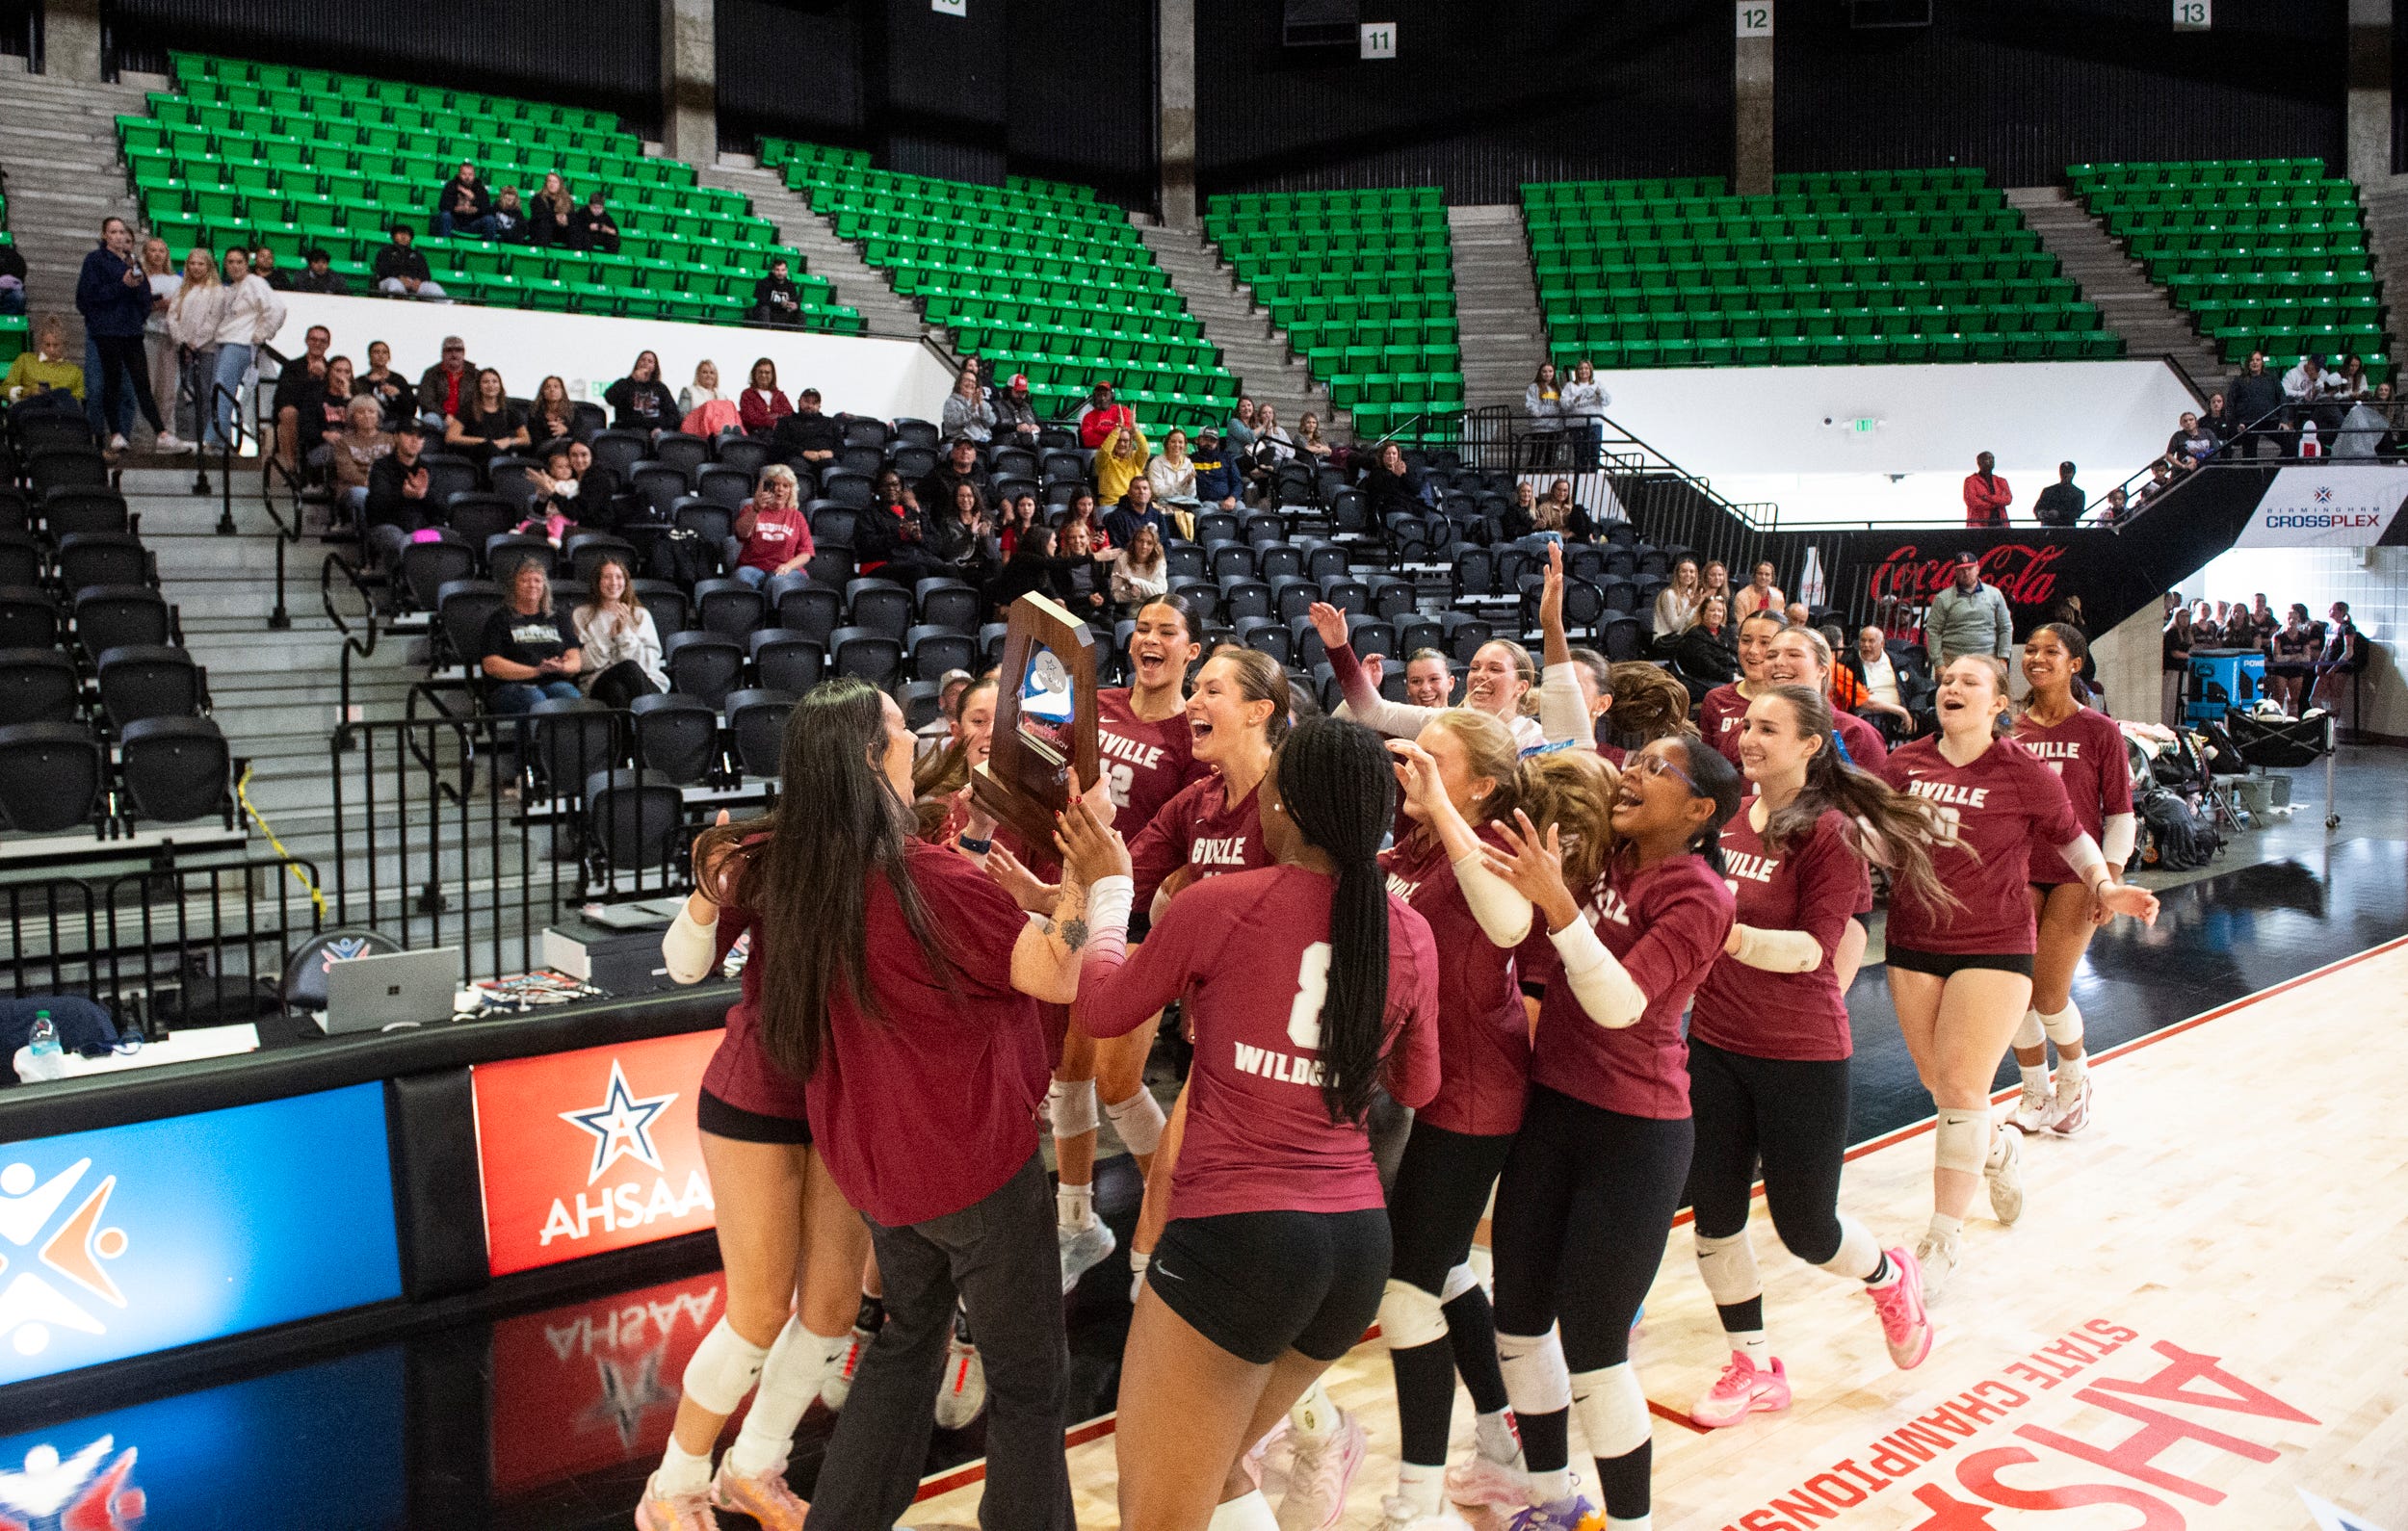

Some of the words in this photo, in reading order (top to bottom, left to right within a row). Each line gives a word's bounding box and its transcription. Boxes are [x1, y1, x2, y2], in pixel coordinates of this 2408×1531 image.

[1742, 9, 1767, 29] 12
[2180, 3, 2205, 23] 13
[1369, 31, 1389, 50] 11
[2265, 514, 2380, 529] CROSSPLEX
[1720, 846, 1781, 883] VILLE
[538, 1169, 717, 1246] AHSAA
[2002, 1318, 2139, 1390] STATE
[1721, 1379, 2030, 1531] CHAMPIONS
